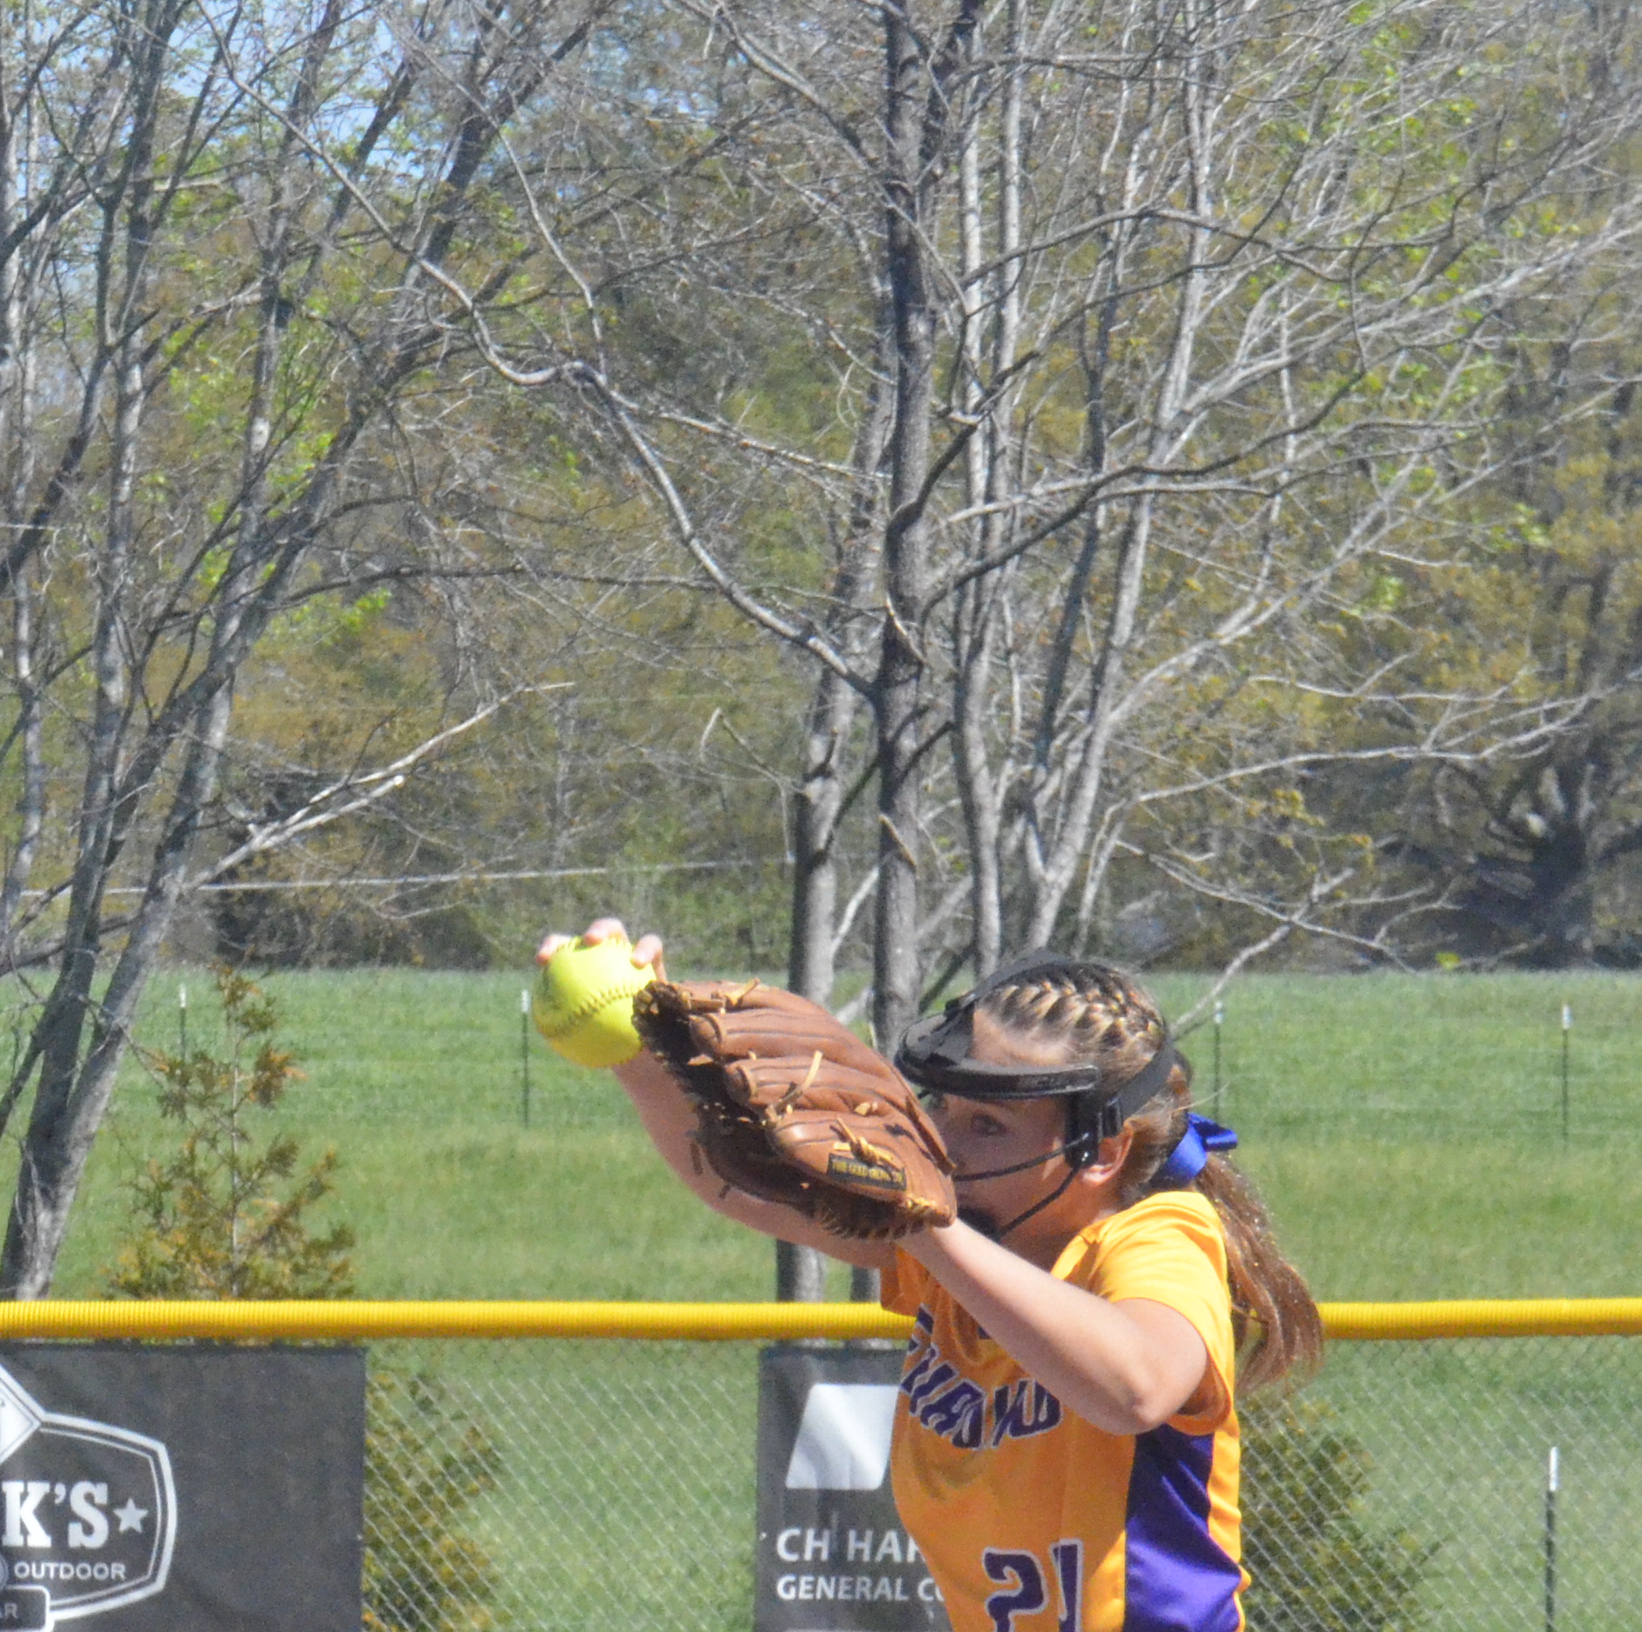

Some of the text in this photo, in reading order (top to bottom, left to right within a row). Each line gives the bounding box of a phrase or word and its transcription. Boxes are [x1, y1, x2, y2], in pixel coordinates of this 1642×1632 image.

[776, 1528, 830, 1562] CH
[14, 1561, 127, 1580] OUTDOOR
[776, 1573, 909, 1600] GENERAL
